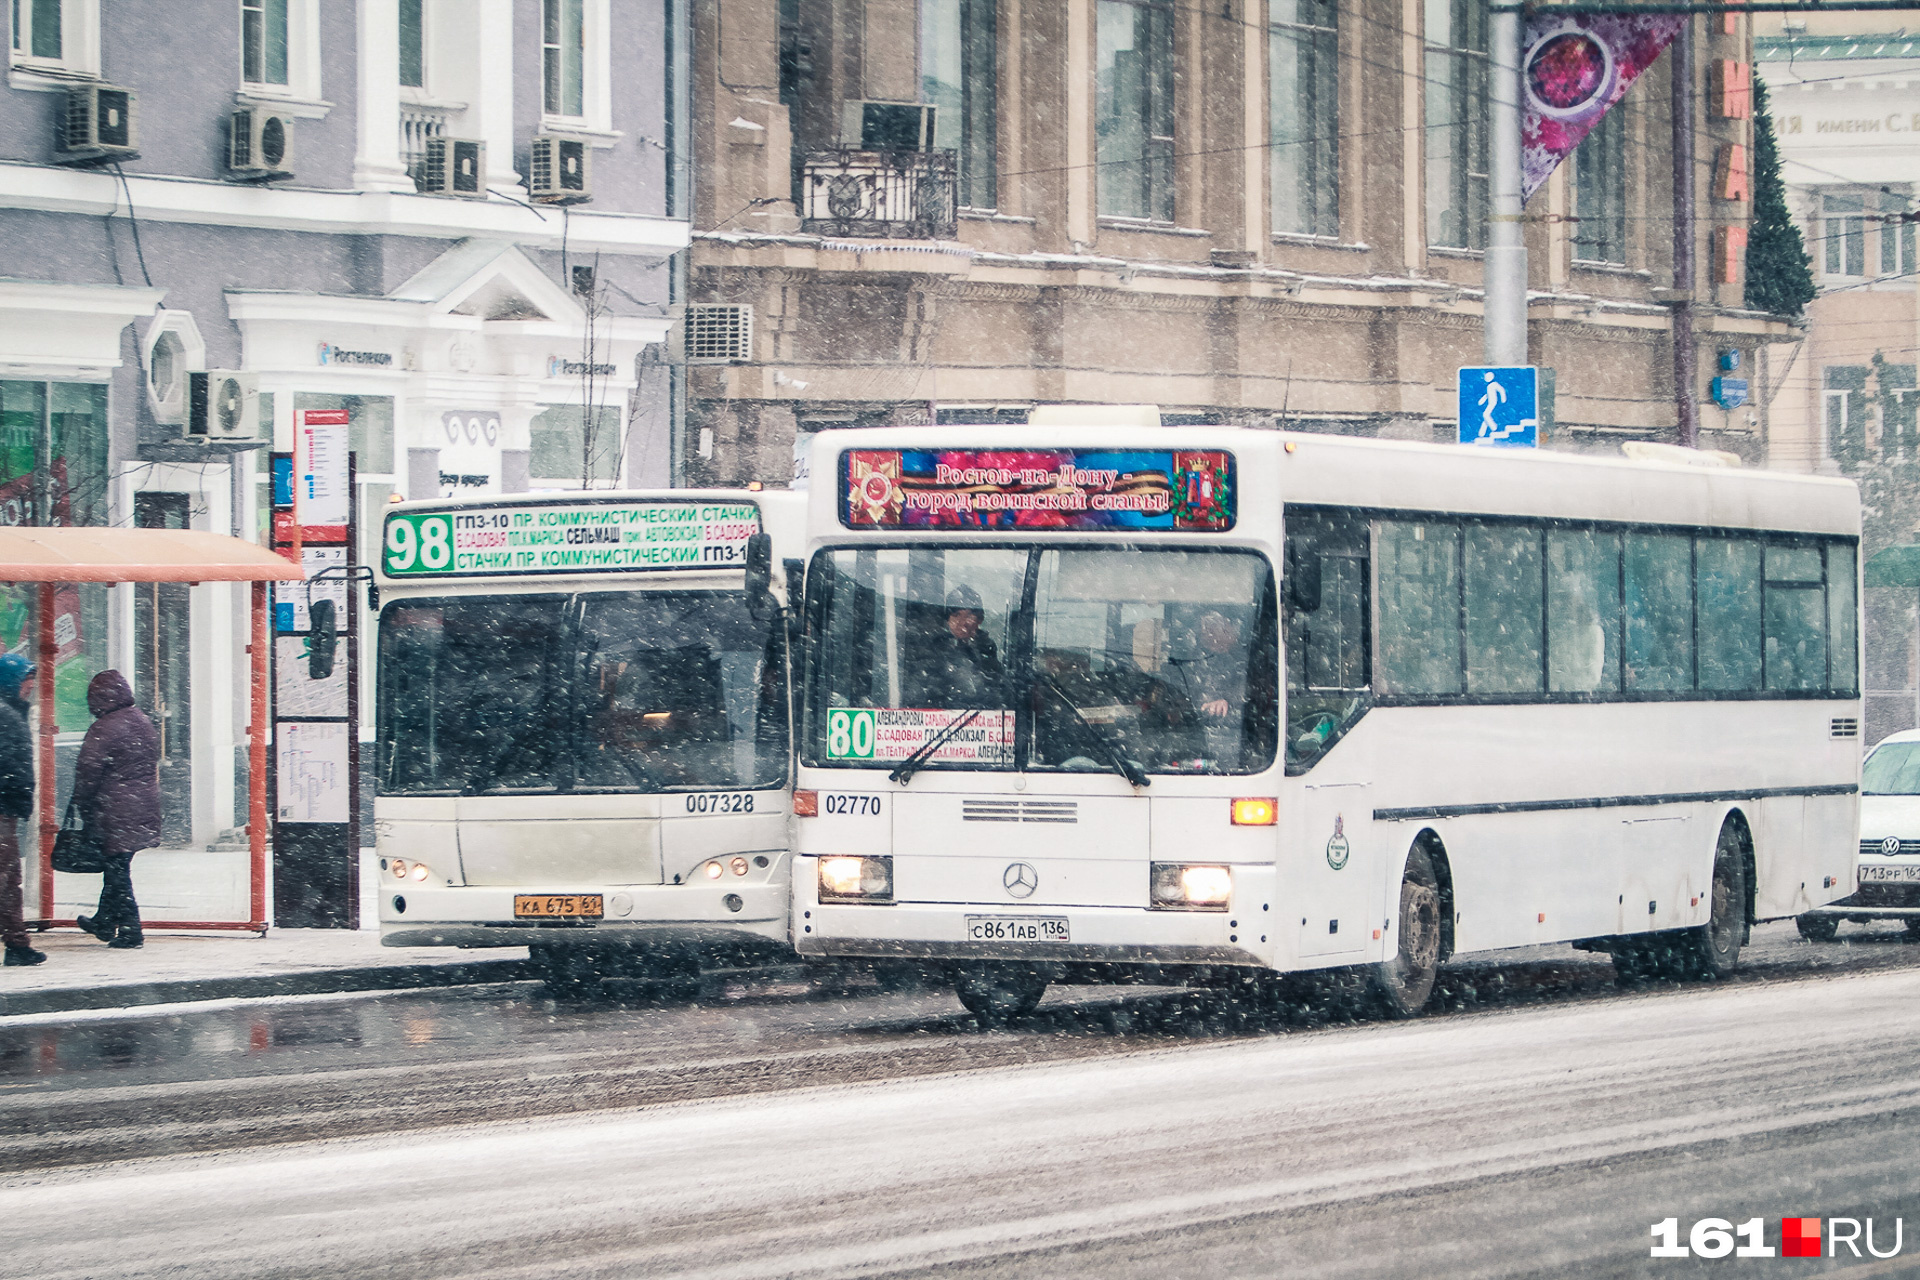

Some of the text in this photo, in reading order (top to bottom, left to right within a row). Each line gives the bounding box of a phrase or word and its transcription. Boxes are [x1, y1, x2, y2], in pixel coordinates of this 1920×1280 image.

[936, 463, 1119, 492] Ростов-на-Дону
[905, 488, 1170, 514] город воинской славы!
[456, 504, 758, 529] ГПЗ-10 ПР. КОММУНИСТИЧЕСКИЙ СТАЧКИ
[387, 517, 450, 570] 98
[566, 526, 620, 544] СЕЛЬМАШ
[457, 543, 747, 569] СТАЧКИ ПР. КОММУНИСТИЧЕСКИЙ ГПЗ-1
[829, 711, 873, 756] 80
[876, 729, 923, 742] Б.САДОВАЯ
[686, 793, 754, 813] 007328
[826, 795, 880, 815] 02770
[1861, 867, 1901, 880] 713РР
[522, 901, 540, 914] КА
[546, 897, 575, 913] 675
[973, 921, 1065, 939] С861АВ 136
